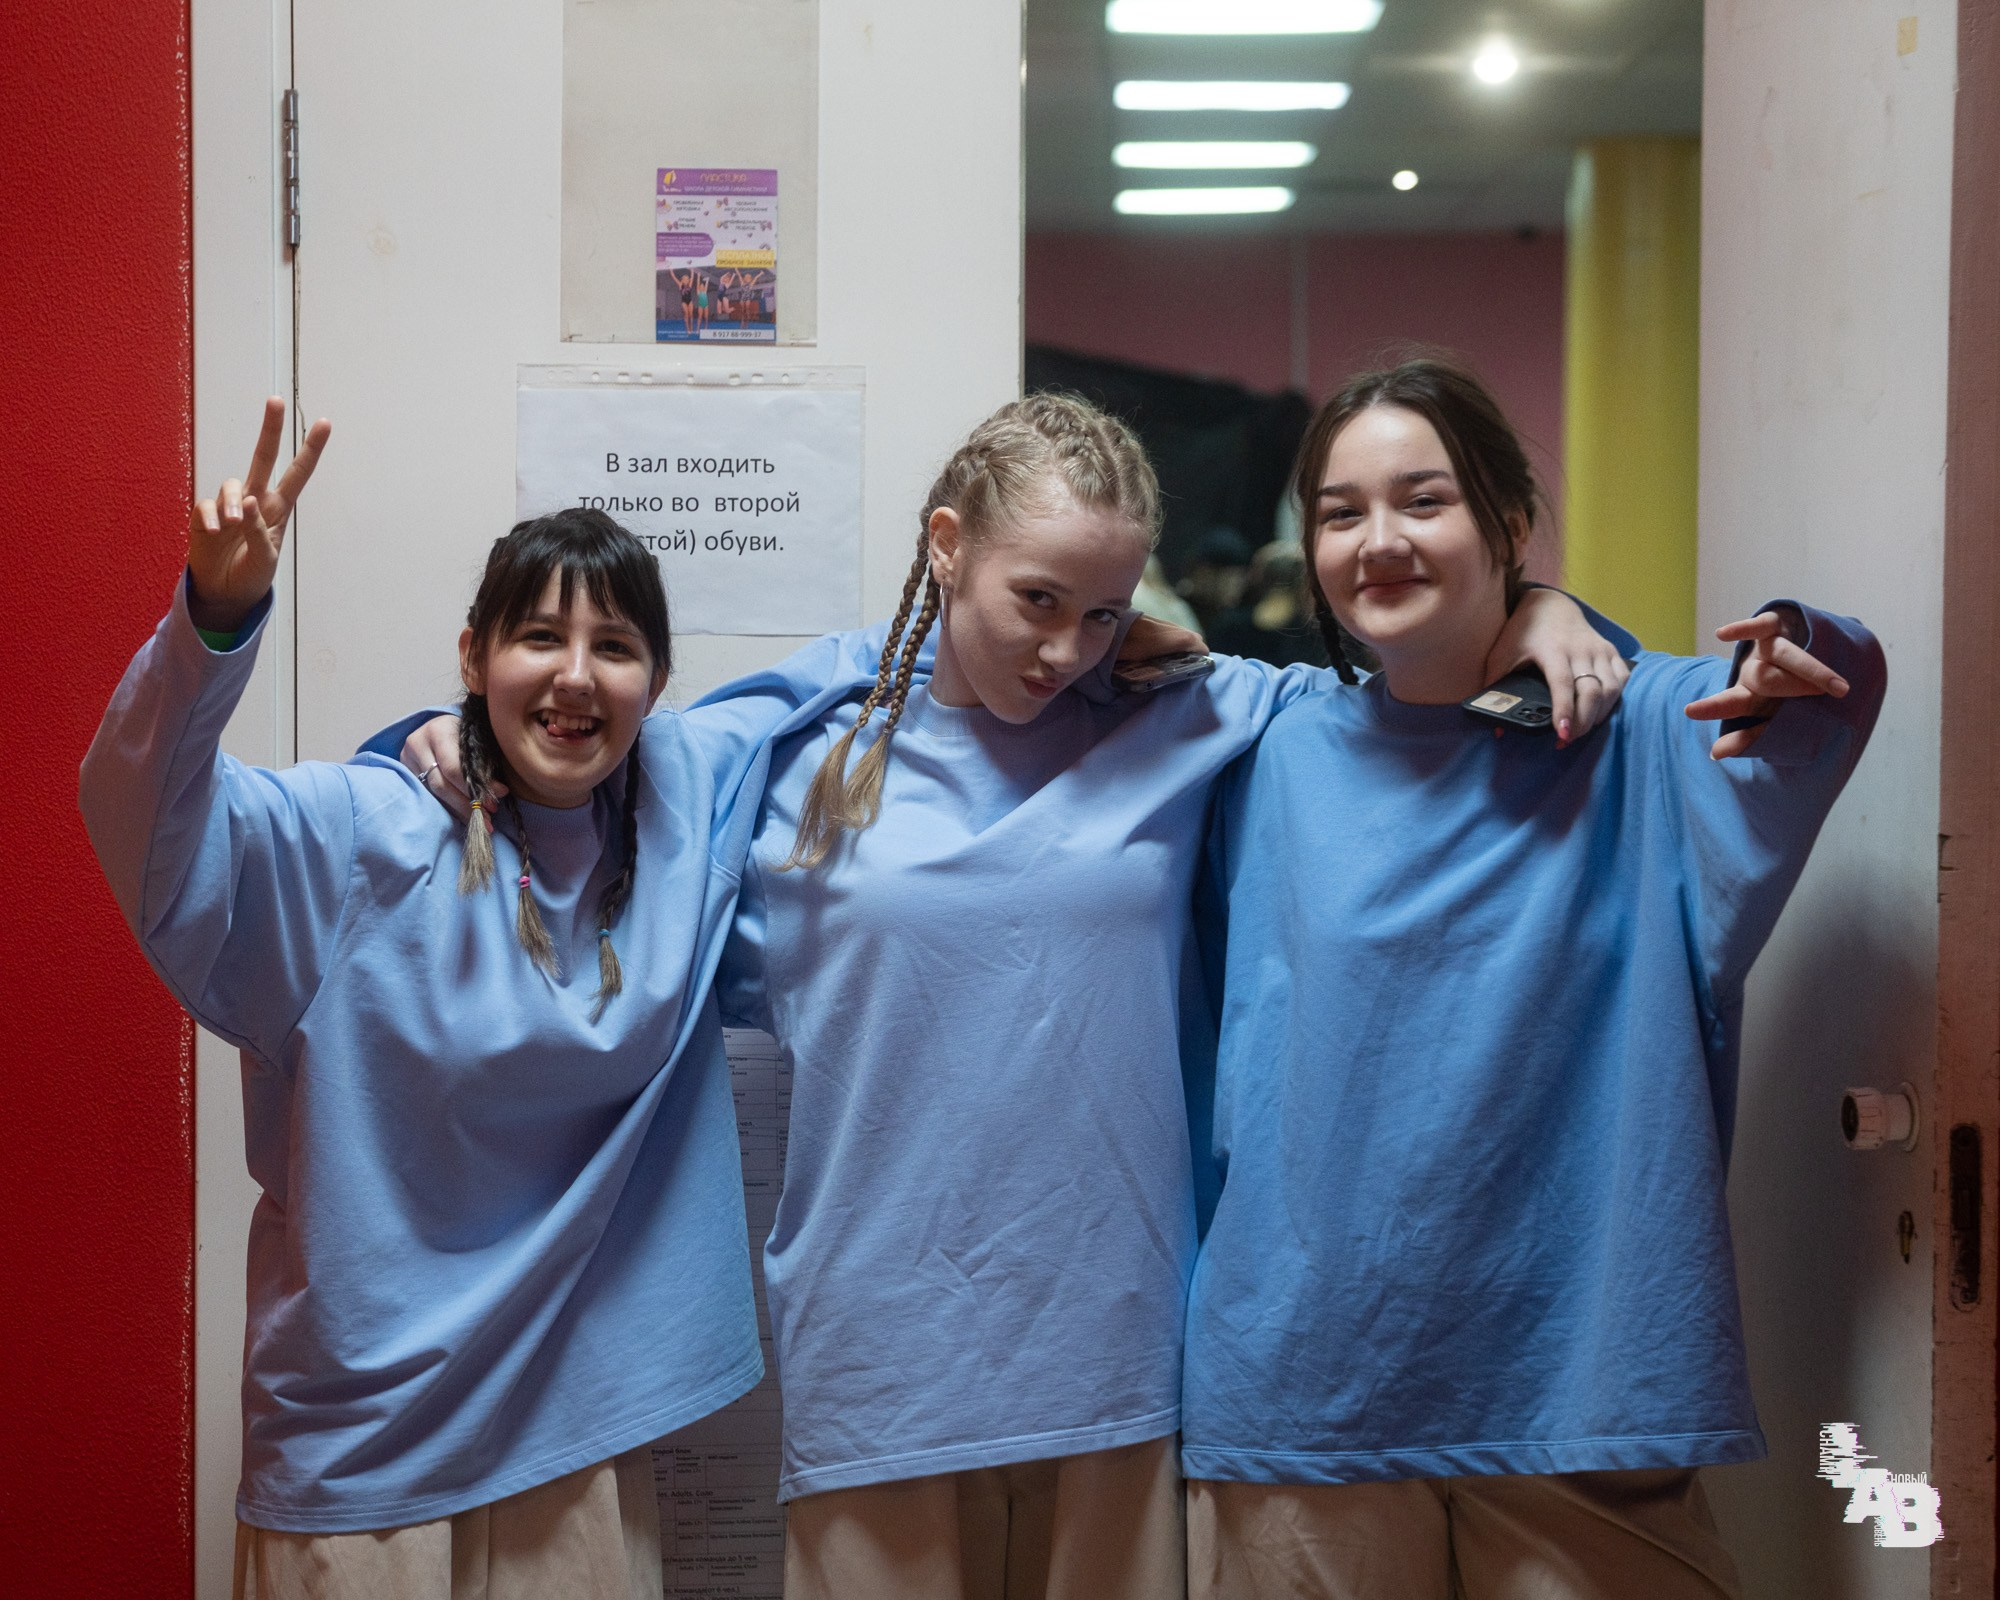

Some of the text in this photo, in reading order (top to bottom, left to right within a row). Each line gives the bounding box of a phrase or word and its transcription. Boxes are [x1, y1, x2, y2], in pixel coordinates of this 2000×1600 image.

[606, 453, 775, 477] В зал входить
[578, 491, 800, 516] только во второй
[705, 529, 784, 555] обуви.
